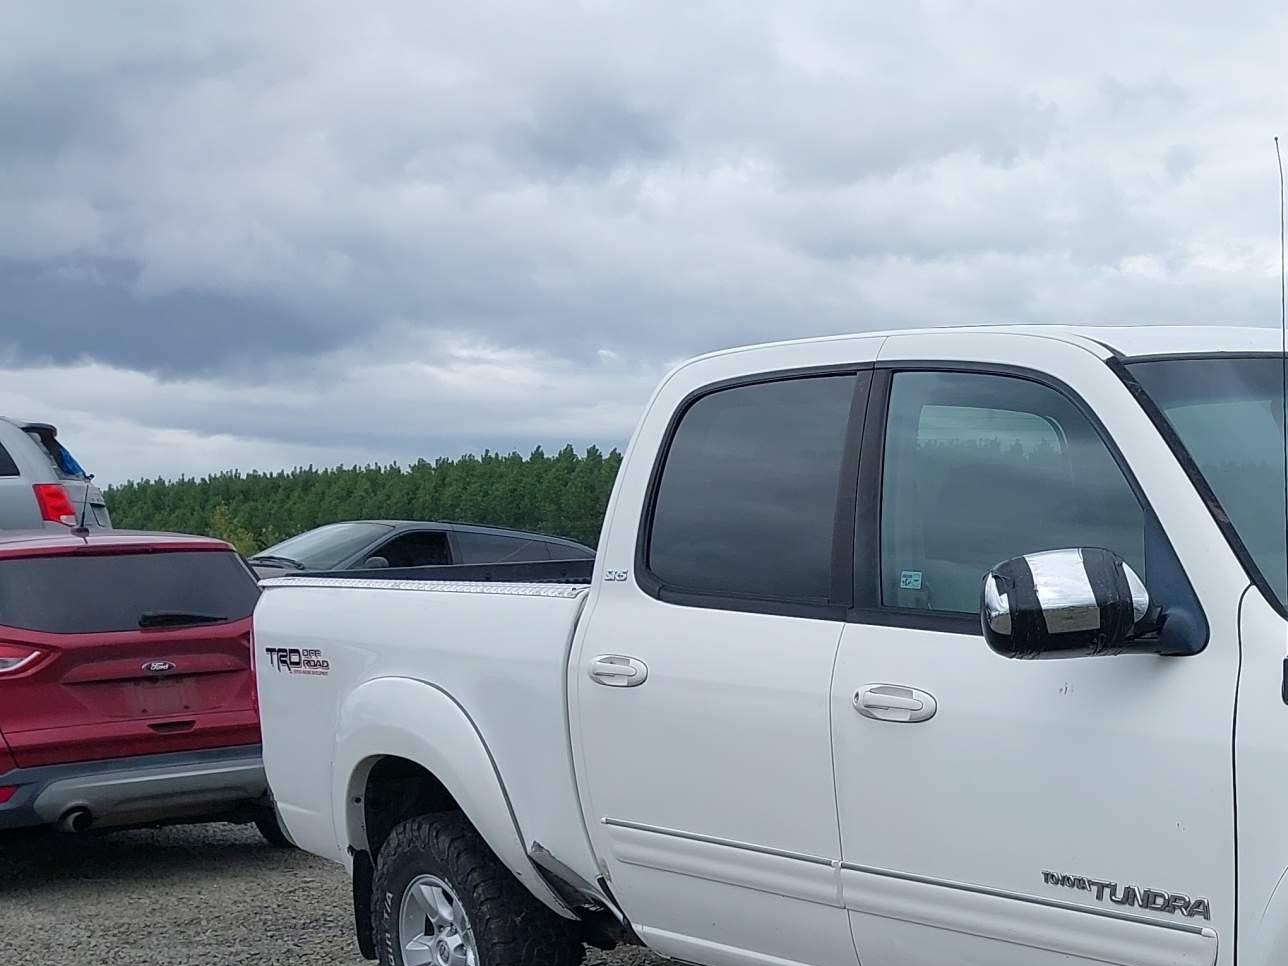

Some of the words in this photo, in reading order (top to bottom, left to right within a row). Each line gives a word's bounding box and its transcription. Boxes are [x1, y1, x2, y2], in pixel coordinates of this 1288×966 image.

[265, 647, 302, 673] TRD
[302, 649, 321, 658] OFF
[302, 660, 330, 670] ROAD
[1041, 871, 1091, 891] TOYOTA
[1091, 878, 1211, 920] TUNDRA
